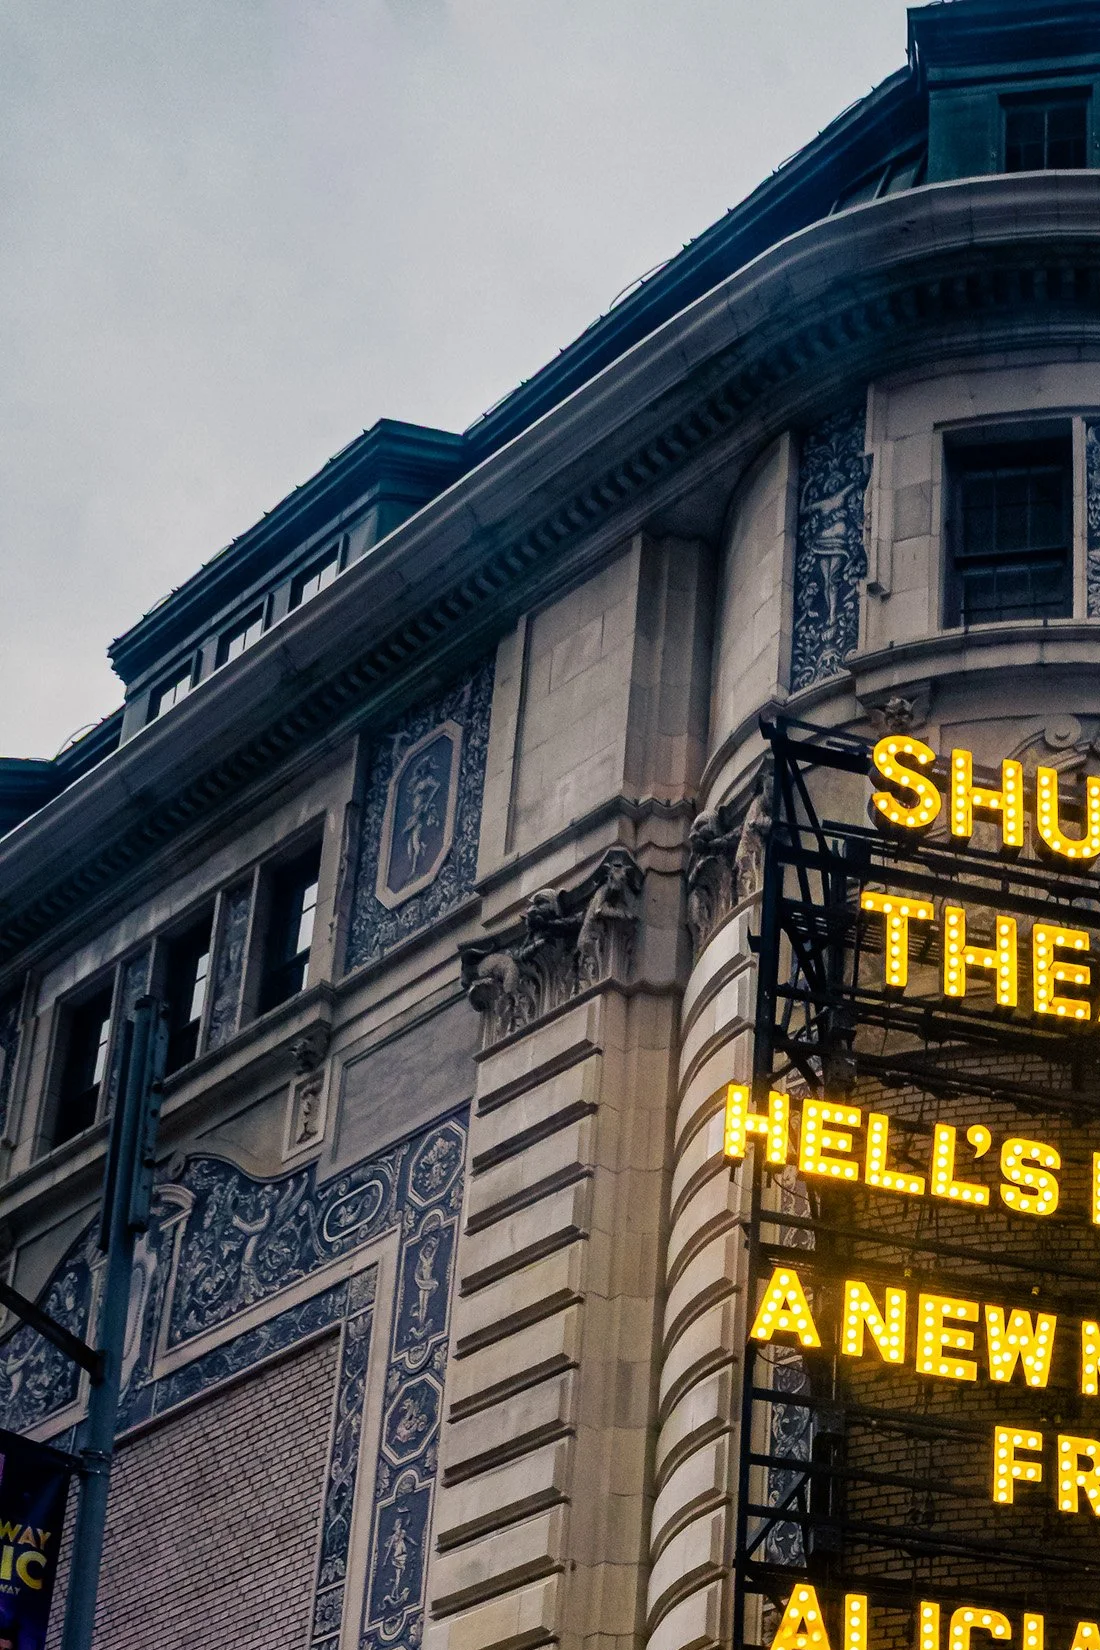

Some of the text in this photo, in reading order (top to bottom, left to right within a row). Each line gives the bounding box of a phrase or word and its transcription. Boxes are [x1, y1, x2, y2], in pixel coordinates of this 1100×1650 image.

[724, 1083, 1061, 1216] HELL'S
[750, 1267, 822, 1349] A
[842, 1281, 1057, 1388] NEW
[0, 1545, 47, 1590] IC
